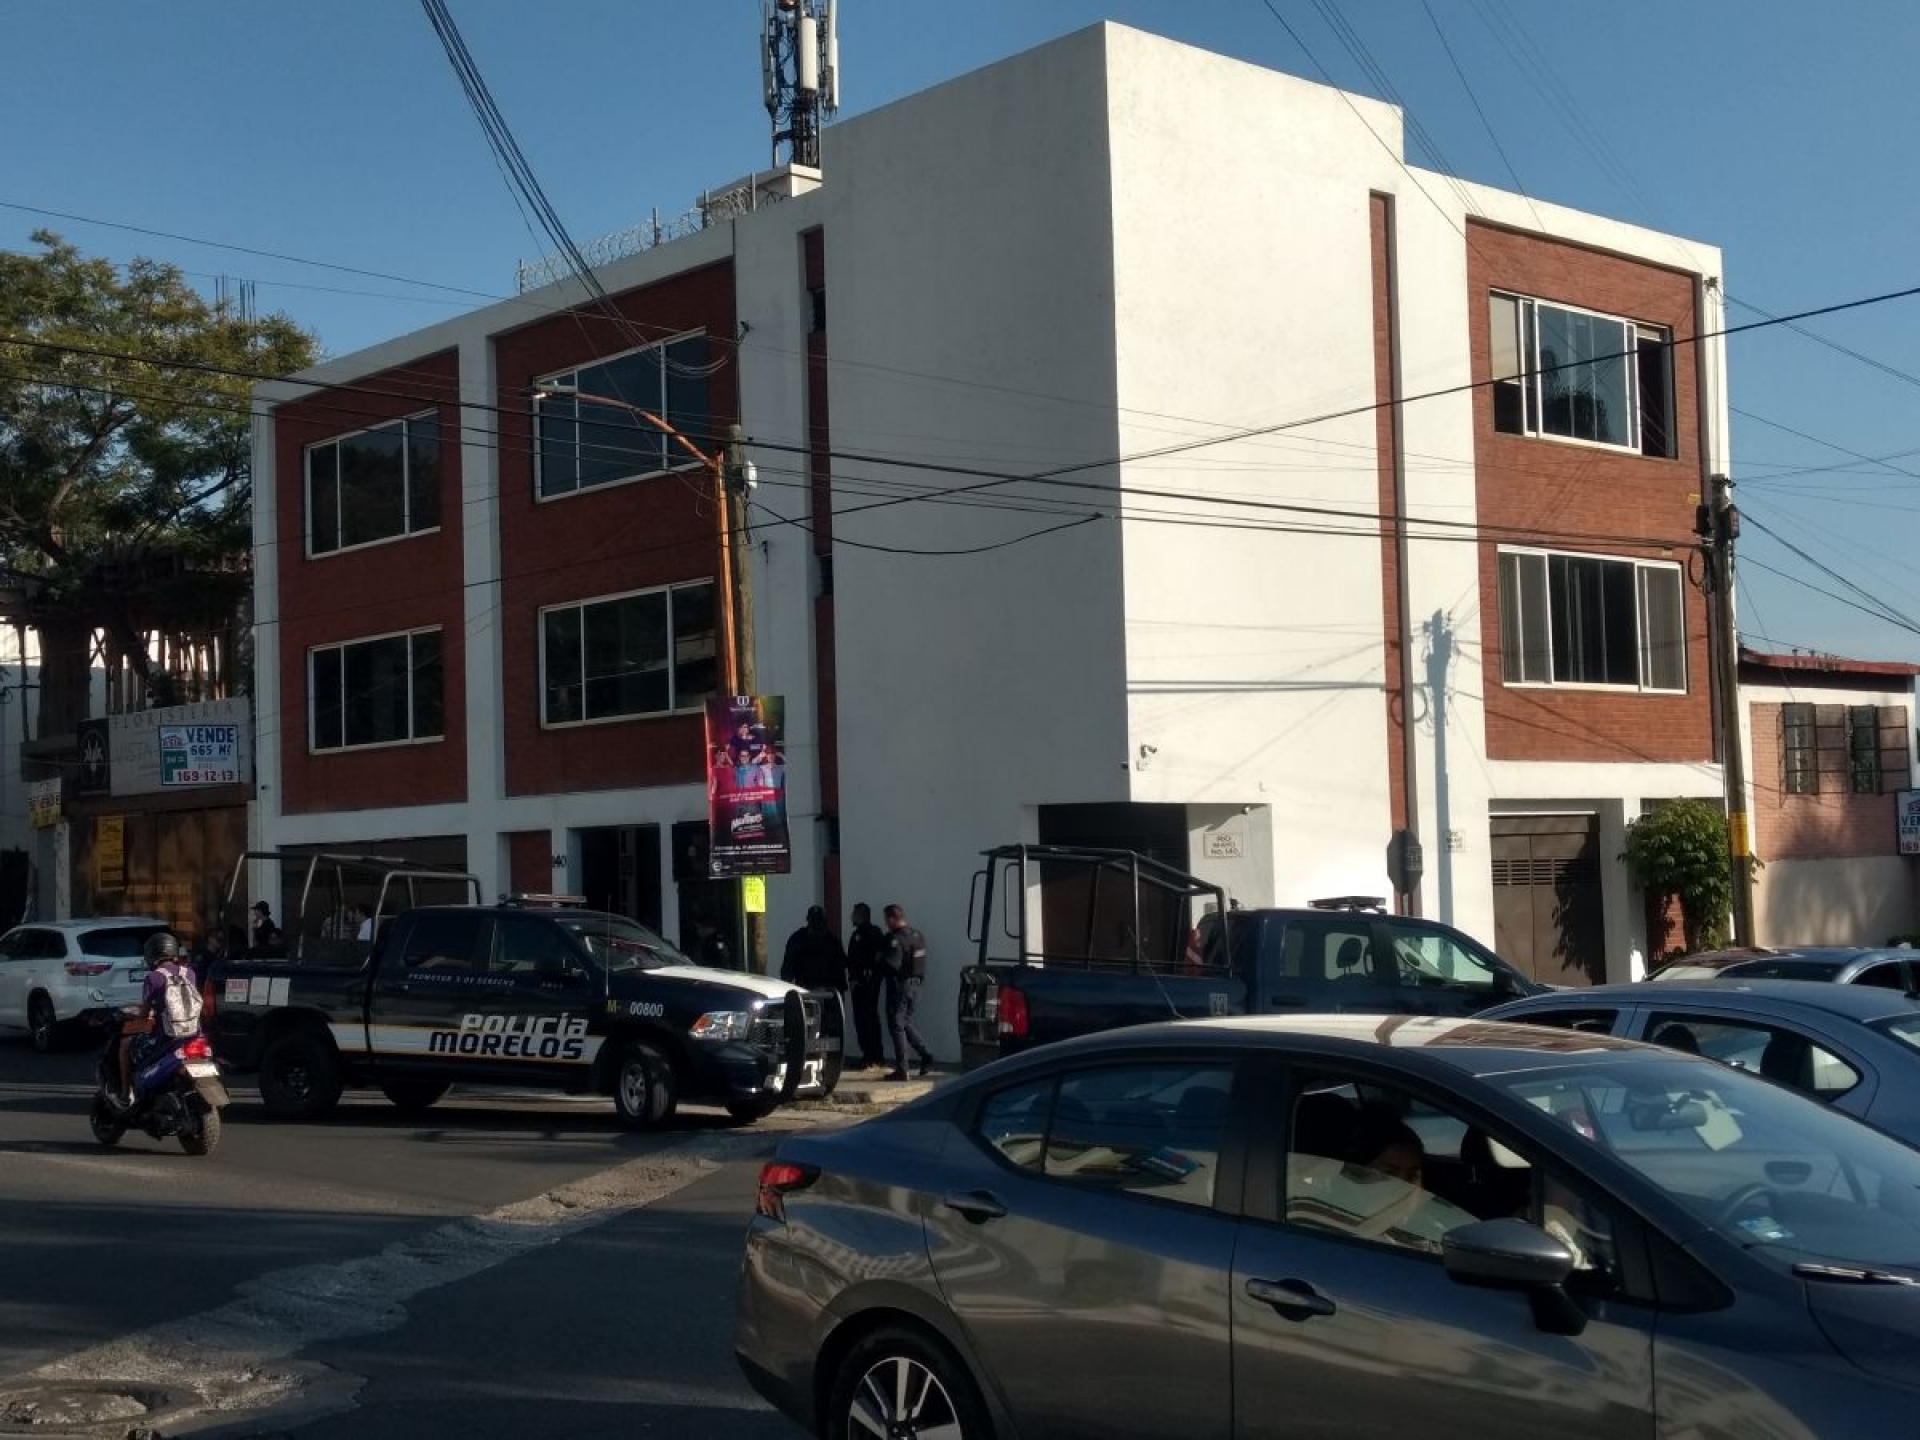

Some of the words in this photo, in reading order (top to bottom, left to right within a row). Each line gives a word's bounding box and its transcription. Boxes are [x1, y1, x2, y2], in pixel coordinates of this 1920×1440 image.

[186, 727, 234, 743] VENDE
[191, 745, 212, 756] 665
[630, 1001, 664, 1016] 00800
[429, 1031, 584, 1059] MORELOS
